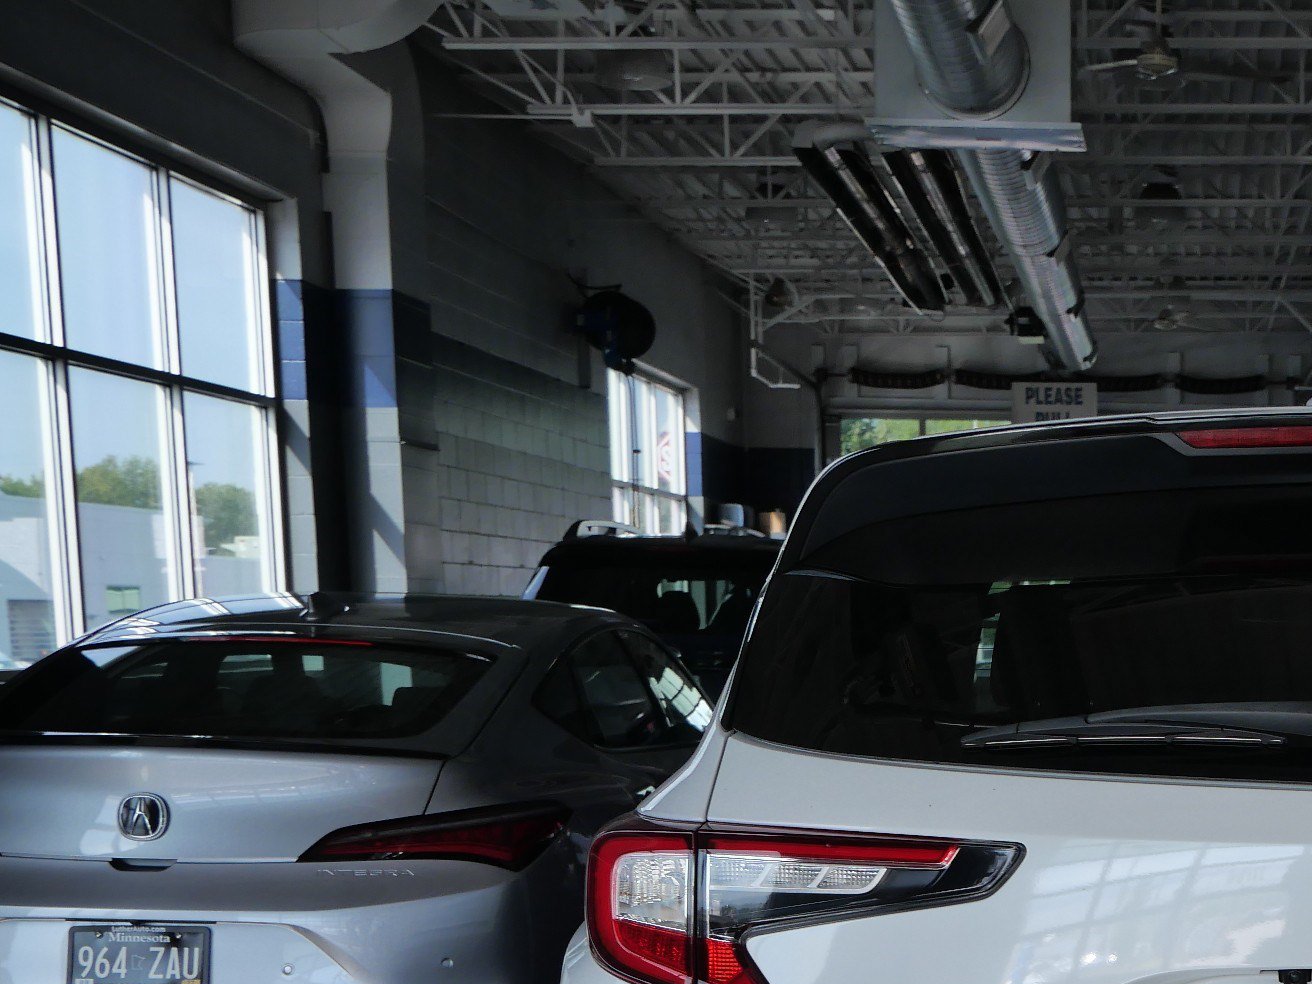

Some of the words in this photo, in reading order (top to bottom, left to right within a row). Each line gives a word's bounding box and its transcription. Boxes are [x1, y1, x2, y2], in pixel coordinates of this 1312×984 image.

[1025, 387, 1083, 405] PLEASE
[108, 932, 171, 943] Minnesota
[78, 945, 128, 979] 964
[148, 946, 200, 980] ZAU
